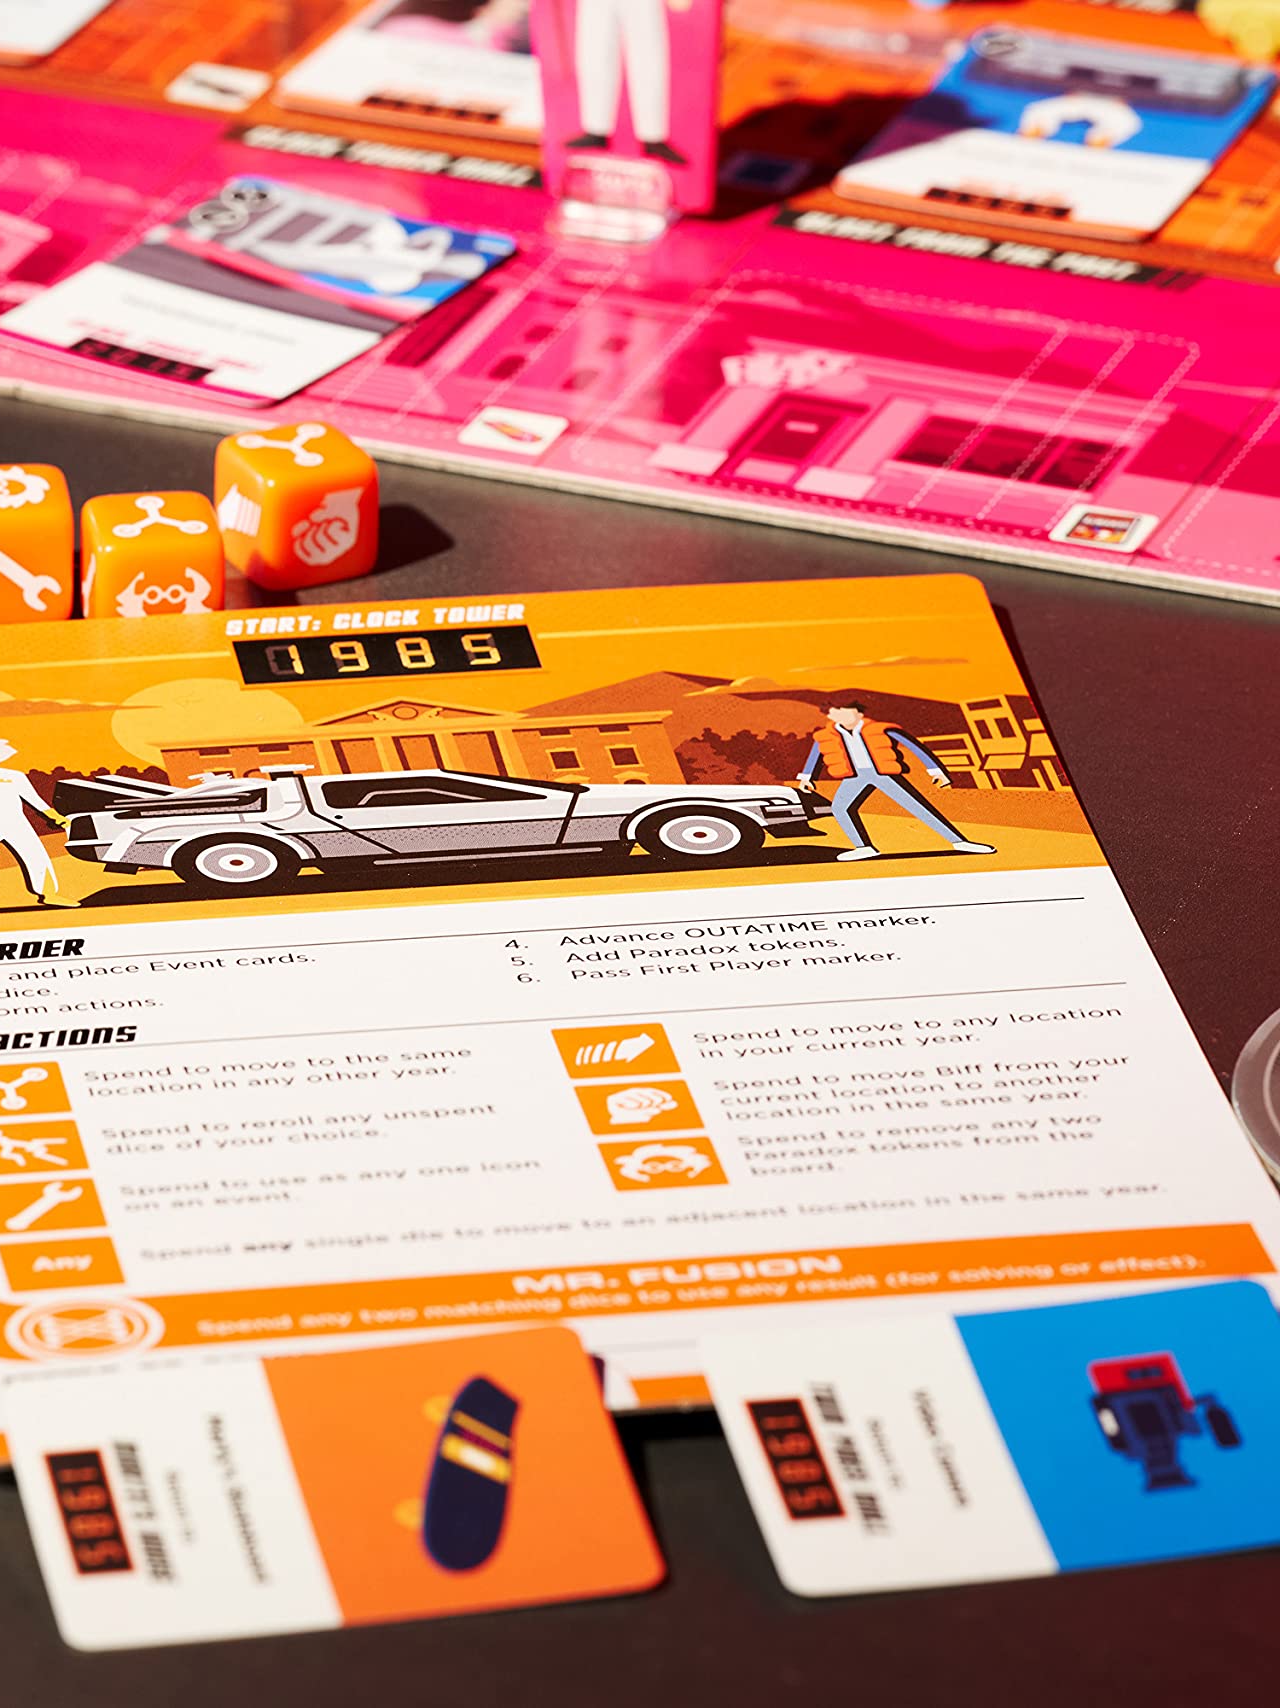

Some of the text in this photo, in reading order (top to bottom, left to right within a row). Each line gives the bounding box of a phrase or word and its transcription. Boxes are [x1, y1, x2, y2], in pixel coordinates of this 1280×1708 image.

[225, 603, 525, 636] START: CLOCK TOWER
[286, 633, 502, 676] 1985
[503, 914, 936, 950] 4. Advance OUTATIME marker.
[7, 966, 58, 982] and
[66, 963, 140, 980] place
[148, 957, 227, 973] Event
[234, 951, 317, 967] cards.
[509, 938, 846, 967] 5. Add Paradox tokens.
[515, 951, 902, 984] 6. Pass First Player marker.
[57, 997, 165, 1013] actions.
[692, 1007, 1122, 1044] Spend to move to any location
[699, 1033, 981, 1059] in your current year.
[83, 1049, 472, 1083] Spend to move to the same
[87, 1065, 457, 1097] location in any other year.
[712, 1056, 1129, 1091] Spend to move Biff from your
[719, 1073, 1100, 1105] current location to another
[101, 1103, 495, 1140] Spend to reroll any unspent
[725, 1106, 841, 1121] location
[849, 1102, 875, 1113] in
[883, 1099, 929, 1111] the
[939, 1095, 1013, 1108] same
[105, 1143, 165, 1155] dice
[175, 1137, 203, 1150] of
[214, 1135, 274, 1150] your
[736, 1115, 1103, 1147] Spend to remove any two
[31, 1253, 93, 1273] Any
[511, 1254, 843, 1295] MR. FUSION
